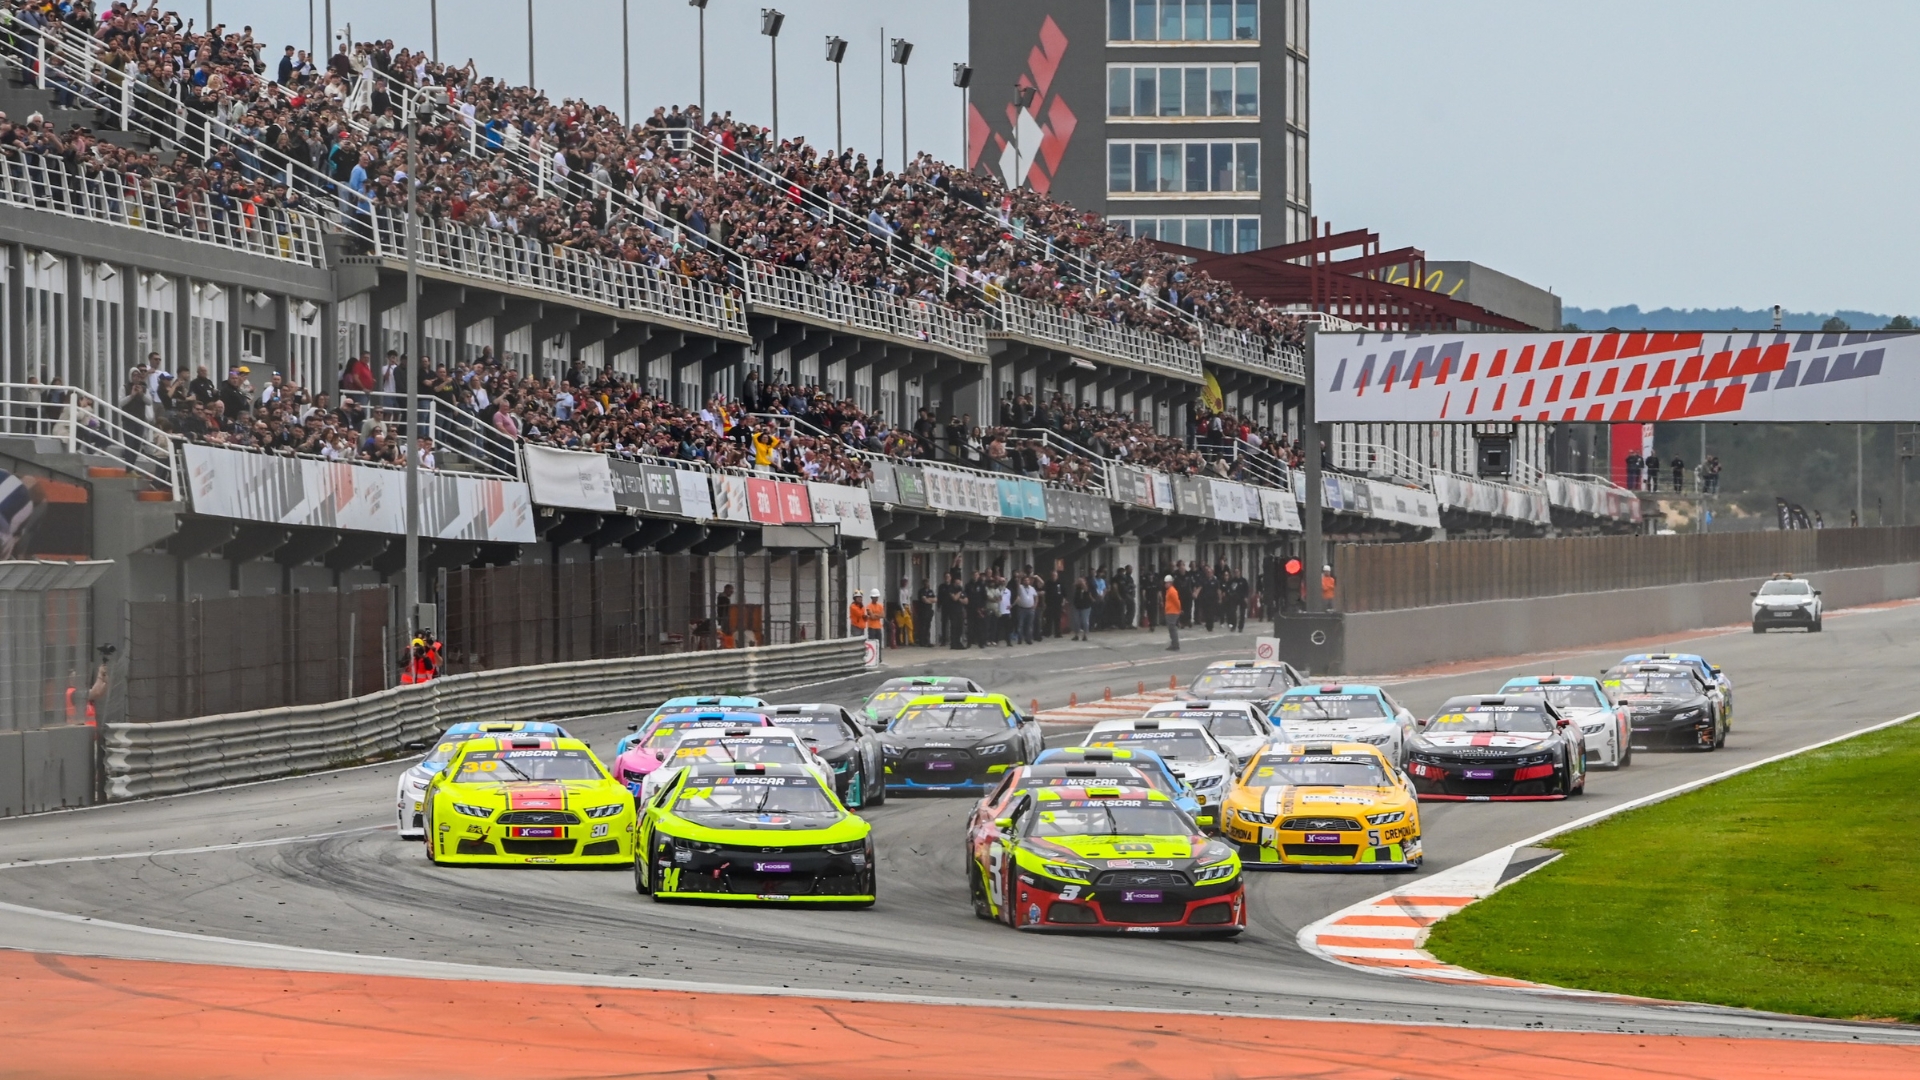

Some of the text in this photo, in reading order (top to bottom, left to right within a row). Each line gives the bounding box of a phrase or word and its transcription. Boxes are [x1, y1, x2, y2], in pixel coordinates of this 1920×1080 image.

[874, 692, 898, 701] 47
[907, 711, 921, 720] 7
[1438, 714, 1465, 723] 48
[675, 747, 707, 758] 99
[463, 761, 498, 773] 30
[1257, 766, 1275, 777] 5
[1415, 765, 1426, 776] 48
[732, 777, 785, 785] NASCAR
[680, 787, 714, 799] 24
[1087, 800, 1141, 808] NASCAR
[1039, 811, 1056, 824] 3
[591, 824, 608, 838] 30
[1384, 826, 1411, 841] CREMONA
[1368, 830, 1380, 846] 5
[663, 867, 681, 892] 24
[1059, 884, 1081, 900] 3
